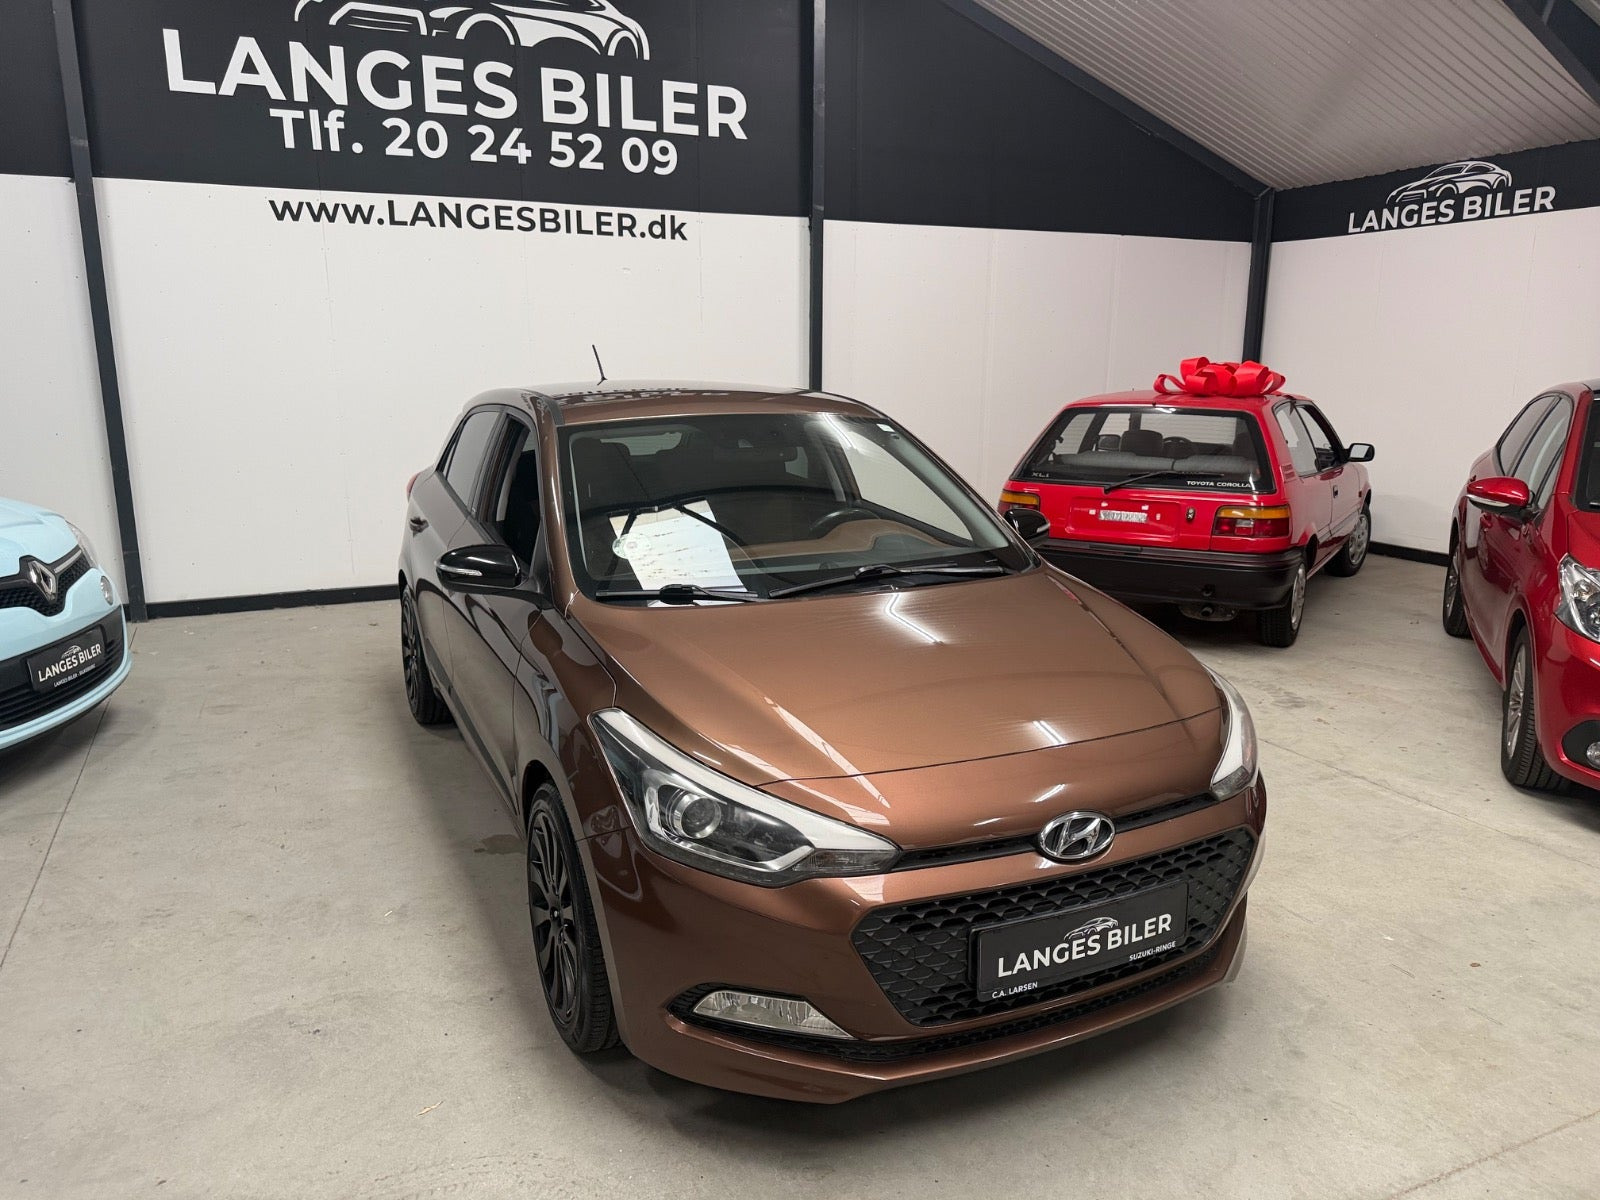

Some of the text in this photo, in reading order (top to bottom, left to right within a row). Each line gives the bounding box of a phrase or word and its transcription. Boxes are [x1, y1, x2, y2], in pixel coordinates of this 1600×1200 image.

[162, 28, 749, 140] LANGES BILER
[269, 107, 678, 176] Tlf. 20 24 52 09
[268, 199, 689, 241] www.LANGESBILER.dk
[1348, 186, 1557, 234] LANGES BILER
[38, 654, 79, 683] LANGES
[78, 643, 102, 664] BILER
[997, 913, 1172, 978] LANGES BILER
[1129, 940, 1177, 962] SUZUKI-RINGE
[991, 981, 1038, 999] C.A. LARSEN
